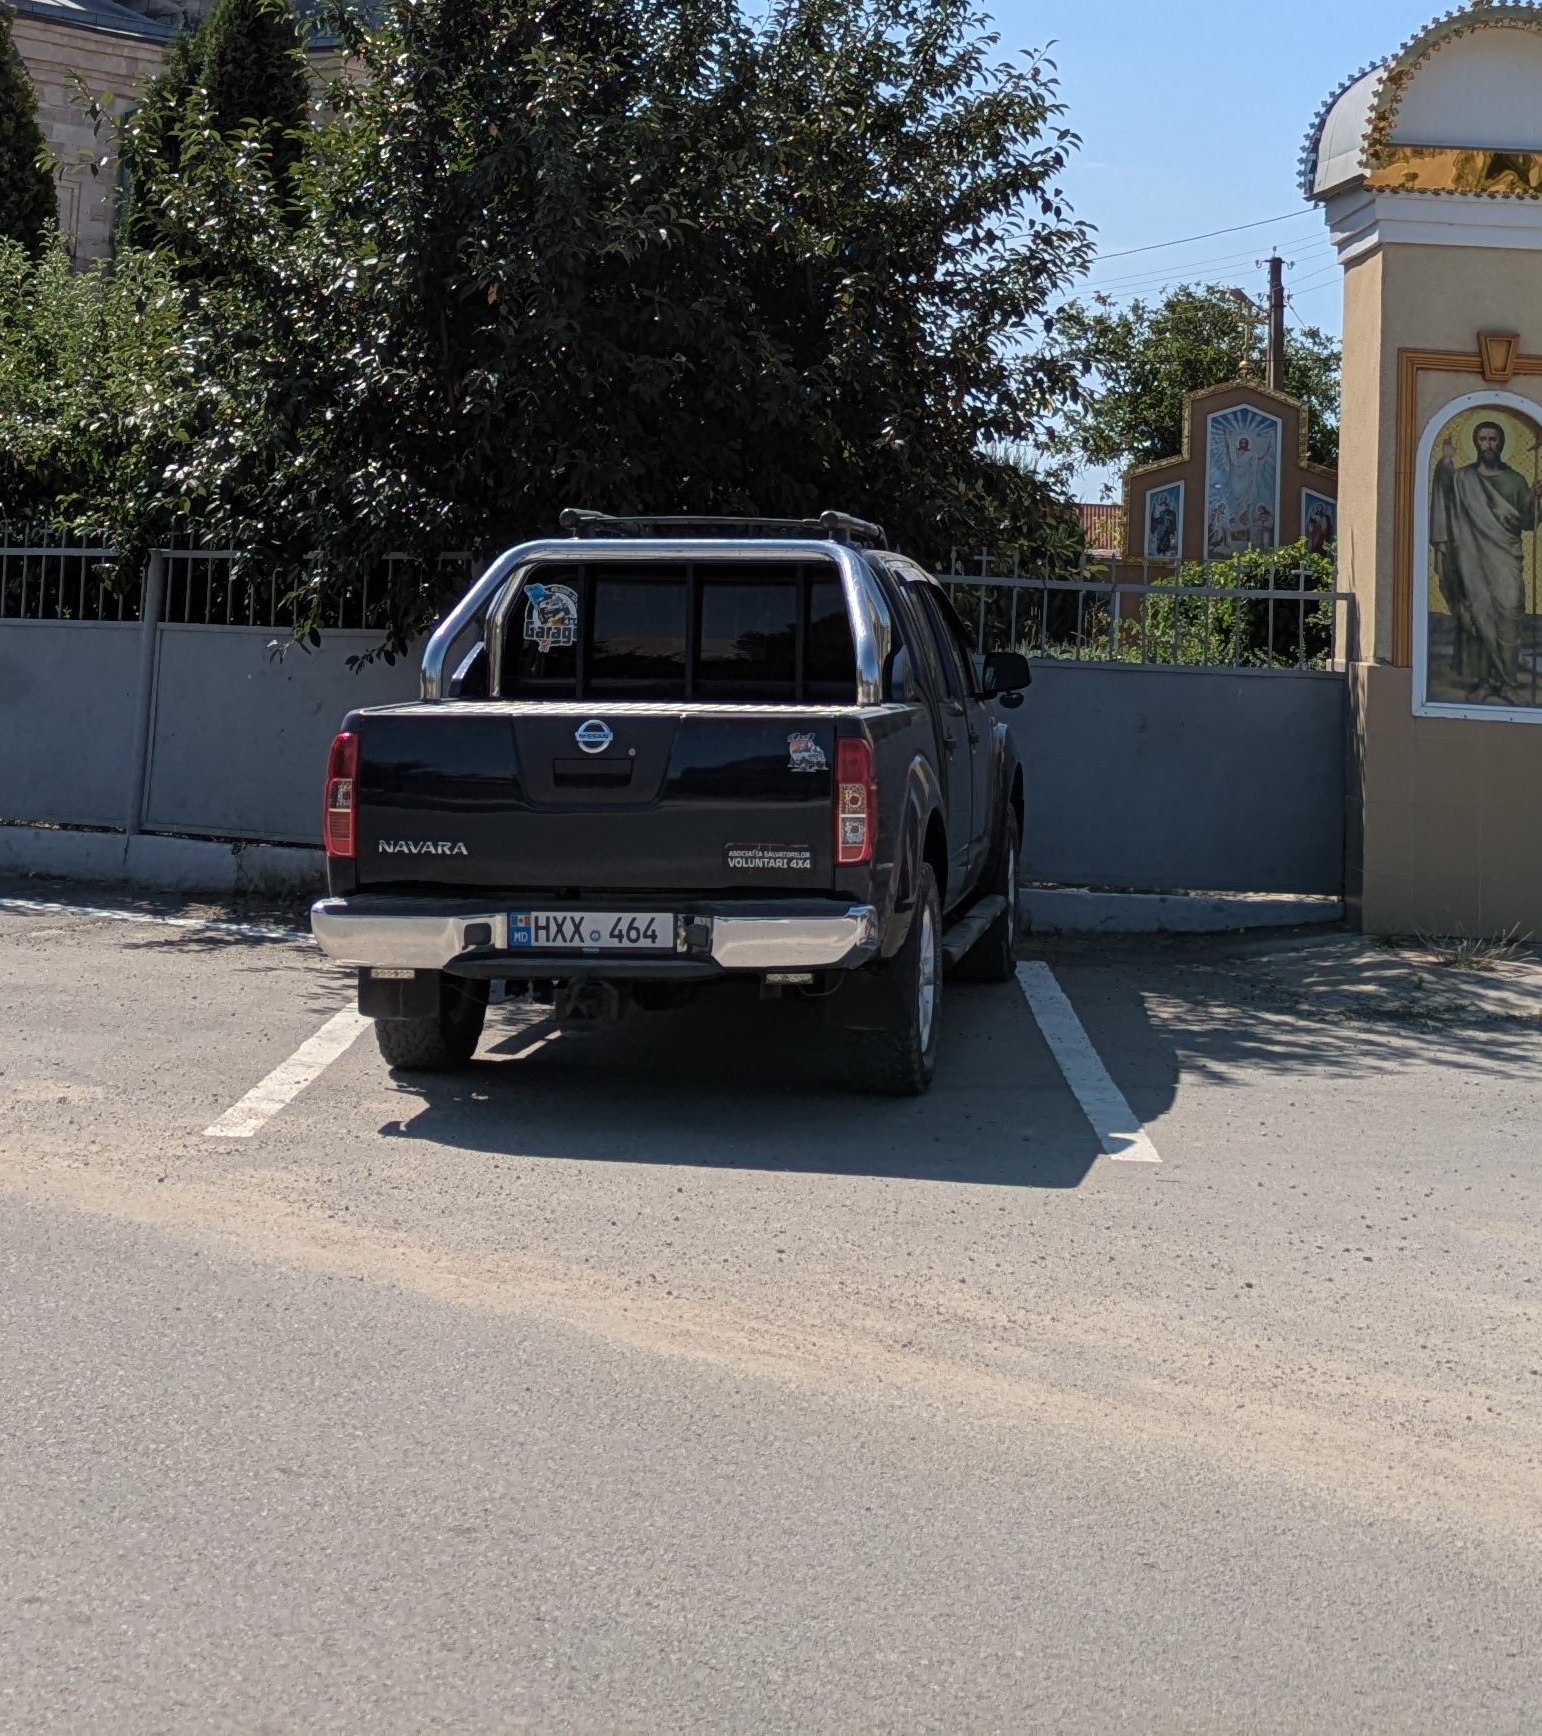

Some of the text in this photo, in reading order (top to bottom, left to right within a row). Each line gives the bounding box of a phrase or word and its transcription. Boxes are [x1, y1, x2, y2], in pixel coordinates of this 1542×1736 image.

[378, 839, 469, 855] NAVARA
[728, 858, 787, 868] VOLUNTARI
[533, 915, 658, 944] HXX 464
[514, 931, 528, 943] MD
